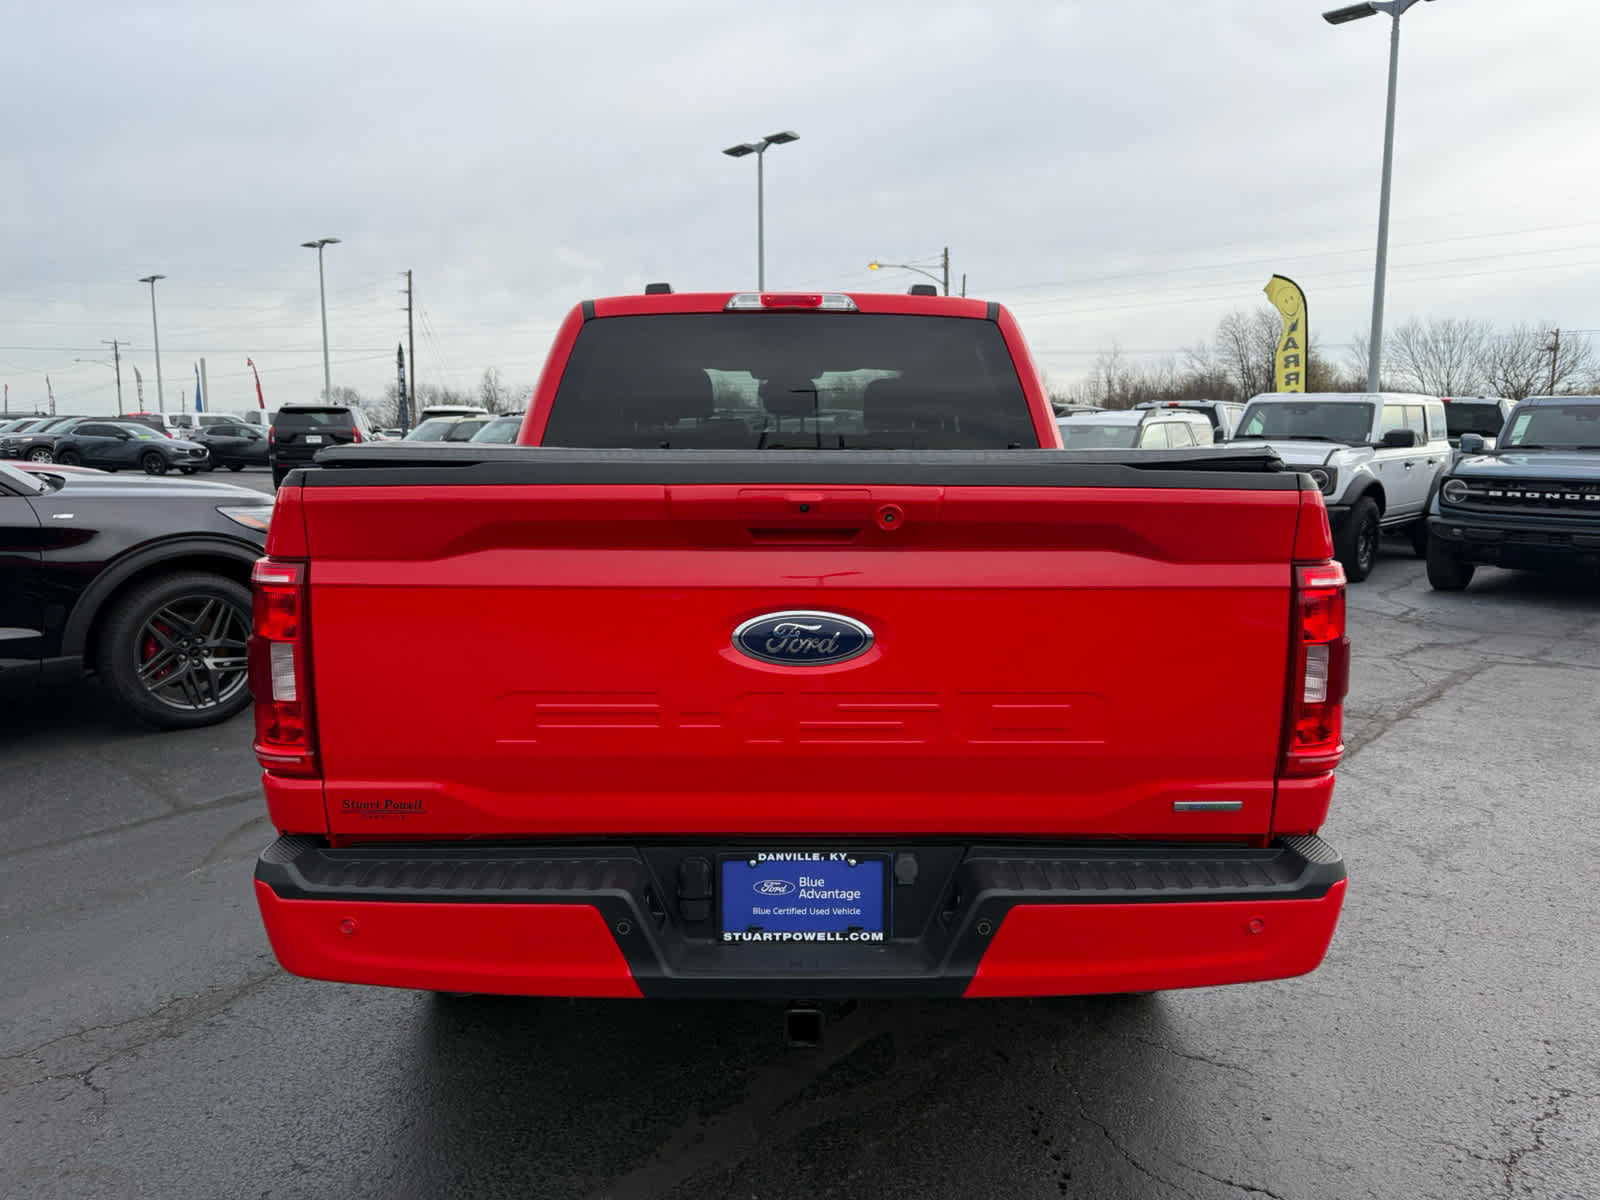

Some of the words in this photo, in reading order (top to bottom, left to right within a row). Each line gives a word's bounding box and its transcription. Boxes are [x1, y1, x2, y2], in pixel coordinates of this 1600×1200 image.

[1488, 490, 1600, 501] BRONCO
[765, 622, 840, 653] Ford
[758, 853, 825, 861] DANVILLE,
[800, 877, 824, 887] Blue
[761, 881, 788, 894] Ford
[799, 889, 861, 901] Advantage
[752, 907, 771, 915] Blue
[773, 907, 807, 915] Certified
[809, 907, 830, 915] Used
[832, 907, 861, 915] Vehicle
[723, 932, 884, 941] STUARTPOWELL.COM
